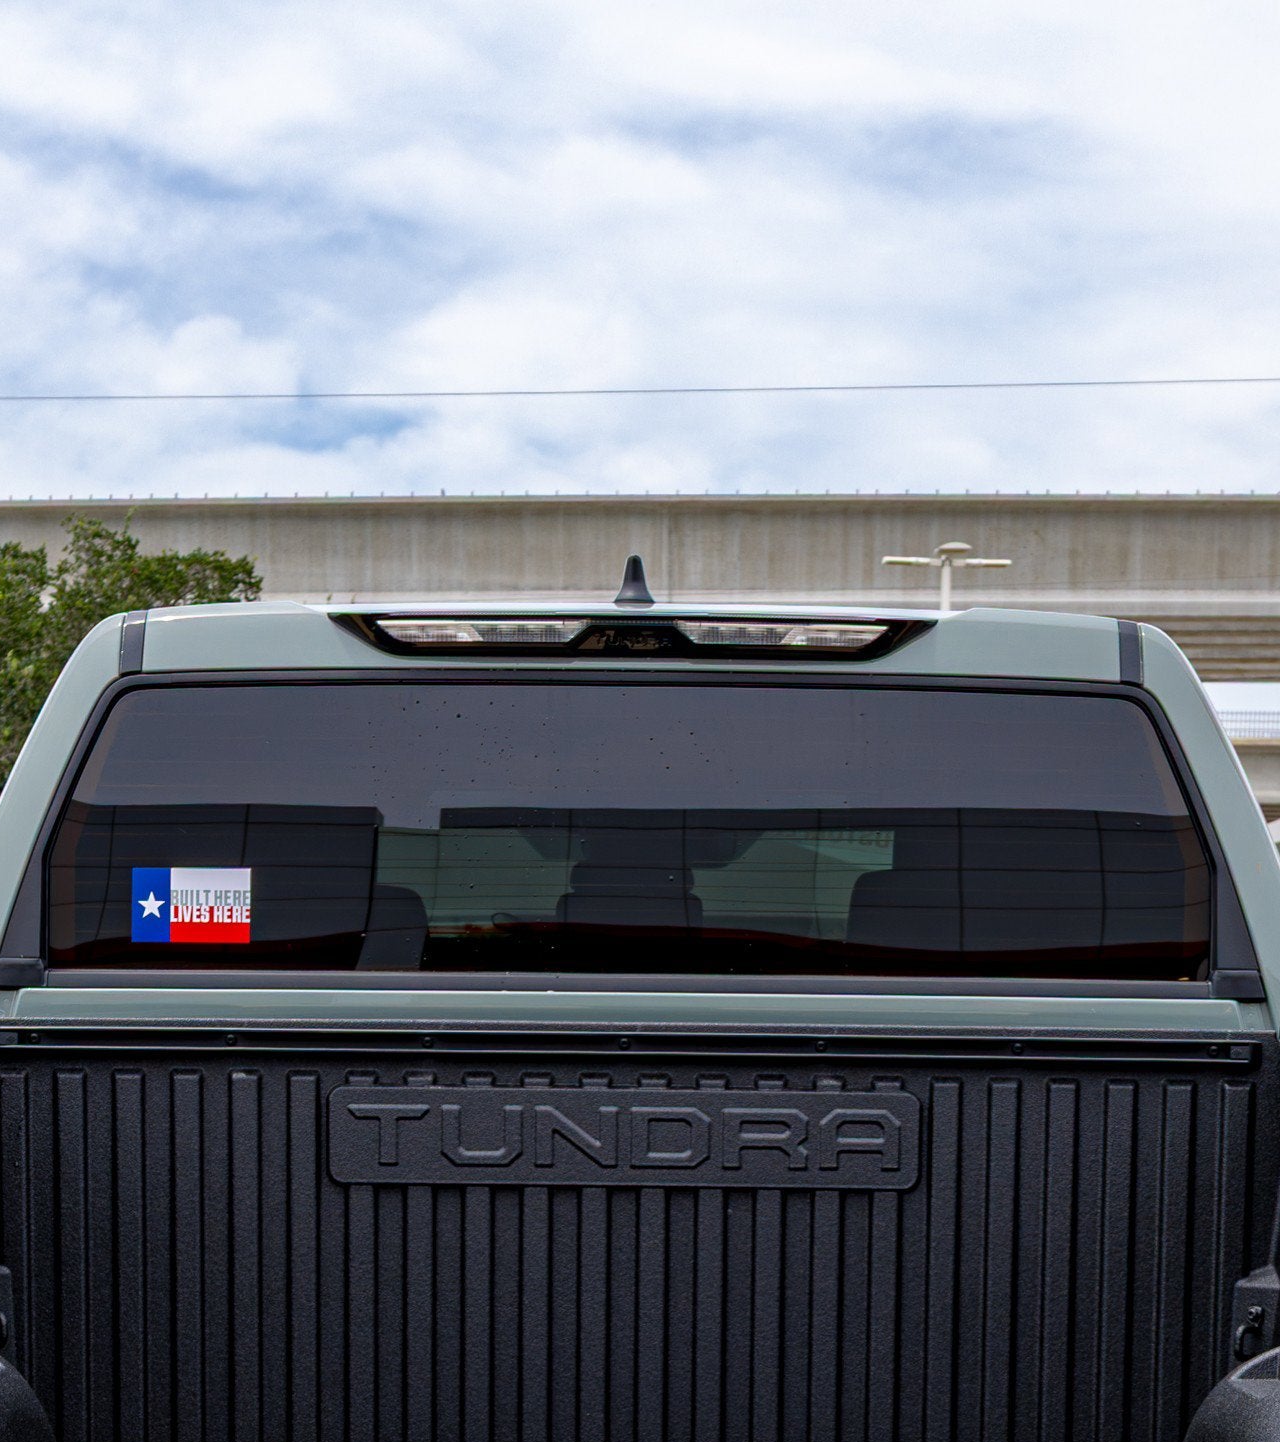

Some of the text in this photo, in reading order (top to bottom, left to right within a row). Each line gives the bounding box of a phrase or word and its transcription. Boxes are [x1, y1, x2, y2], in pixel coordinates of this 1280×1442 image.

[170, 889, 251, 906] BUILT HERE
[170, 906, 251, 923] LIVES HERE
[347, 1102, 902, 1172] TUNDRA
